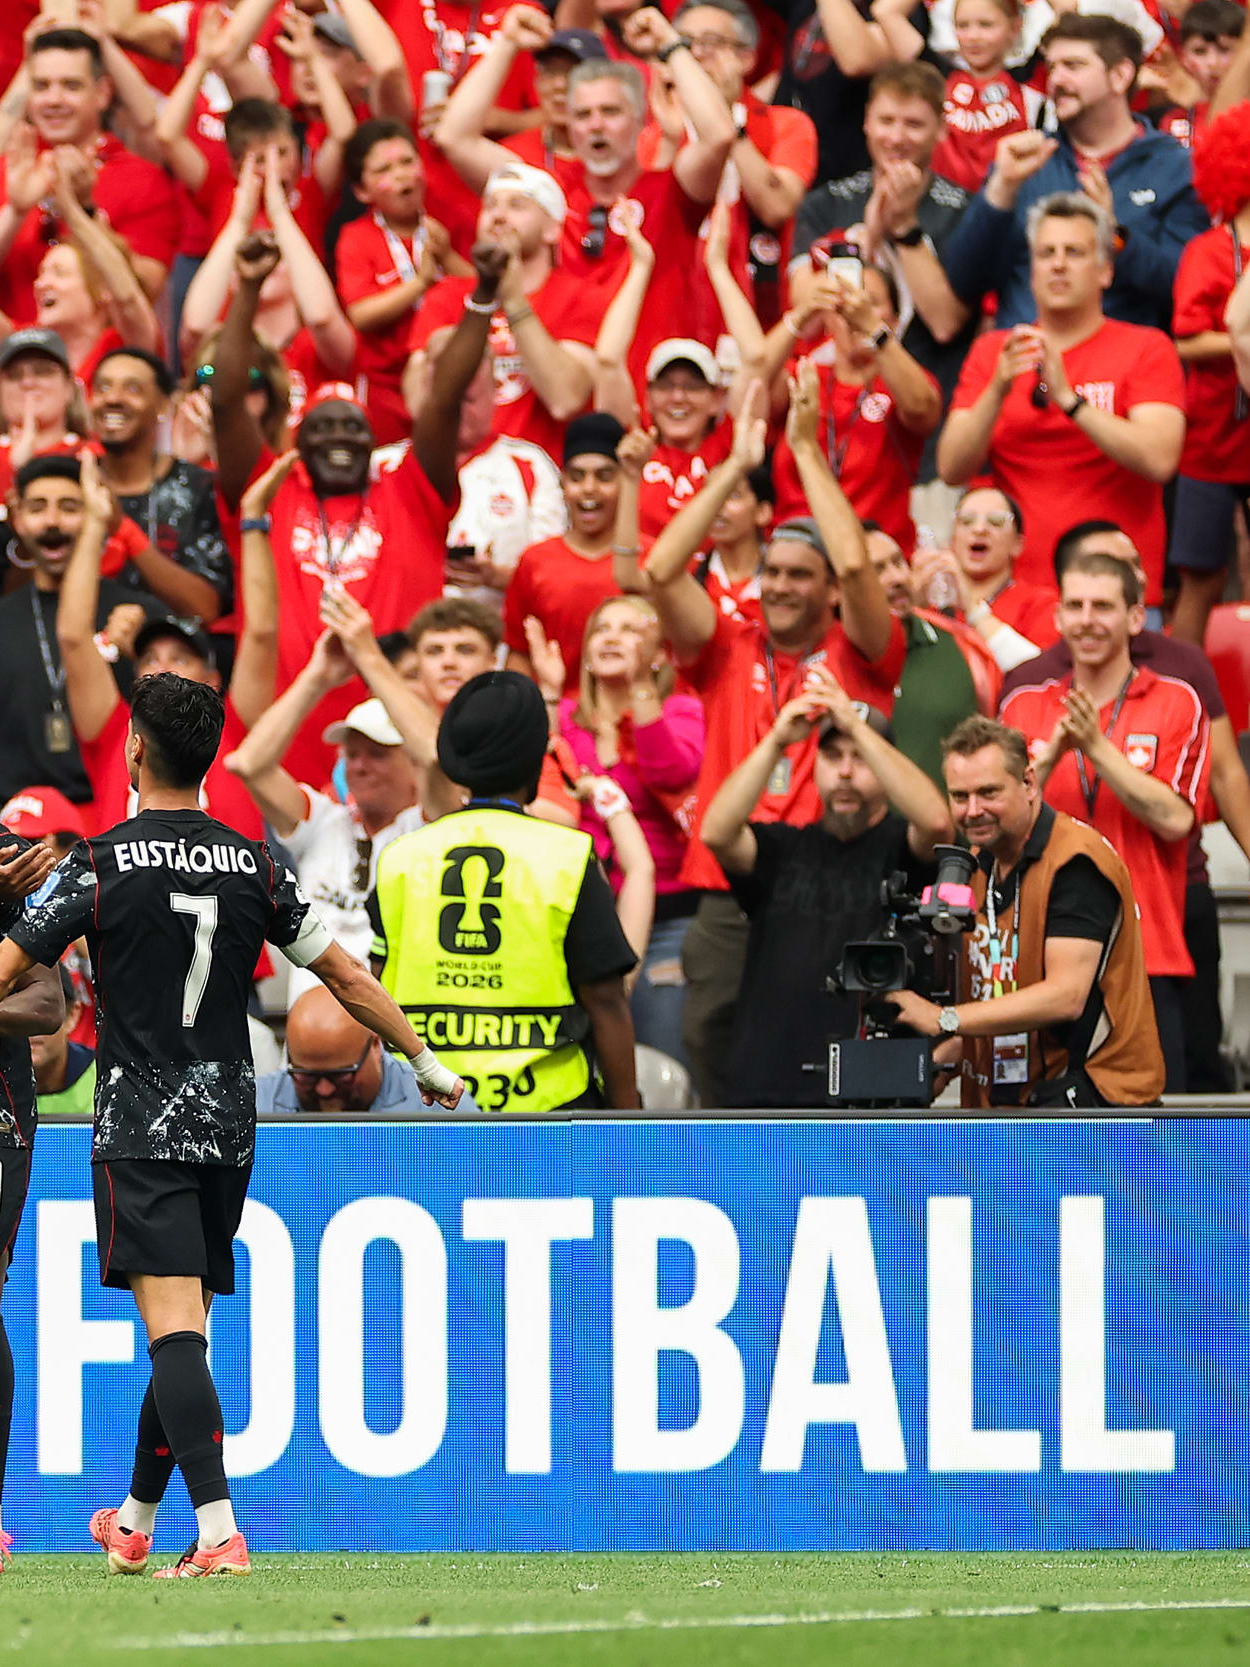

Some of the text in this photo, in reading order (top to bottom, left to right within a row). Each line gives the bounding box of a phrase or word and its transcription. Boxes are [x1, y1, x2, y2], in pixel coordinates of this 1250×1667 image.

[114, 838, 258, 875] EUSTÁQUIO
[454, 932, 489, 949] FIFA
[169, 892, 219, 1028] 7
[436, 960, 502, 972] WORLD CUP
[436, 972, 503, 990] 2026
[405, 1011, 562, 1047] ECURITY
[37, 1195, 1175, 1478] FOOTBALL
